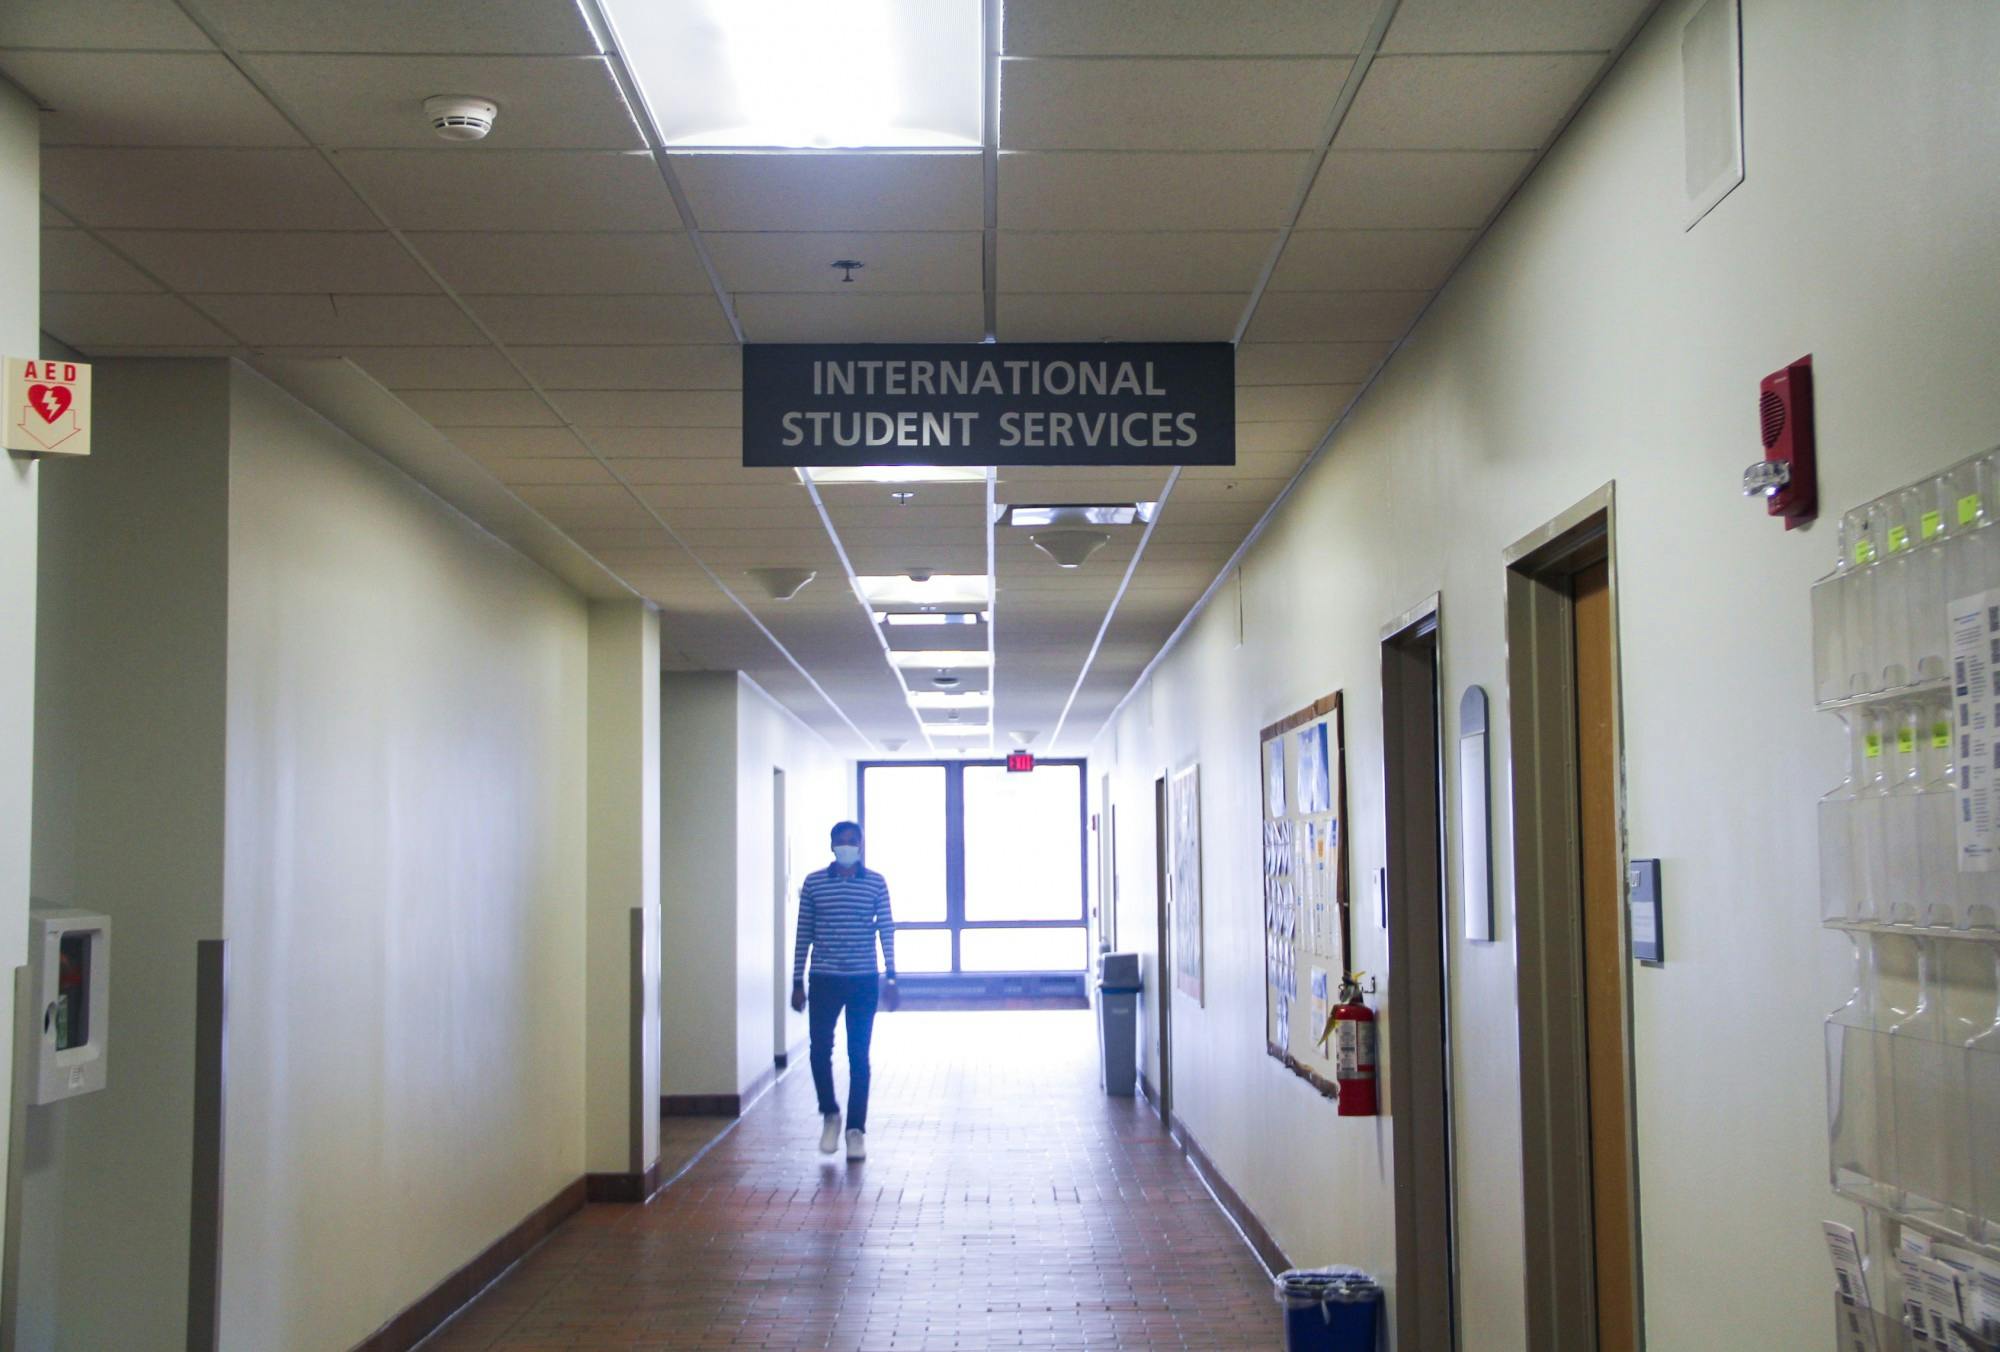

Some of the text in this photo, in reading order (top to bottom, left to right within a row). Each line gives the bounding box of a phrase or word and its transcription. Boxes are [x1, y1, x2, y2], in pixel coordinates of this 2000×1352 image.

[24, 361, 76, 381] AED
[813, 360, 1166, 395] INTERNATIONAL
[781, 411, 1198, 447] STUDENT SERVICES
